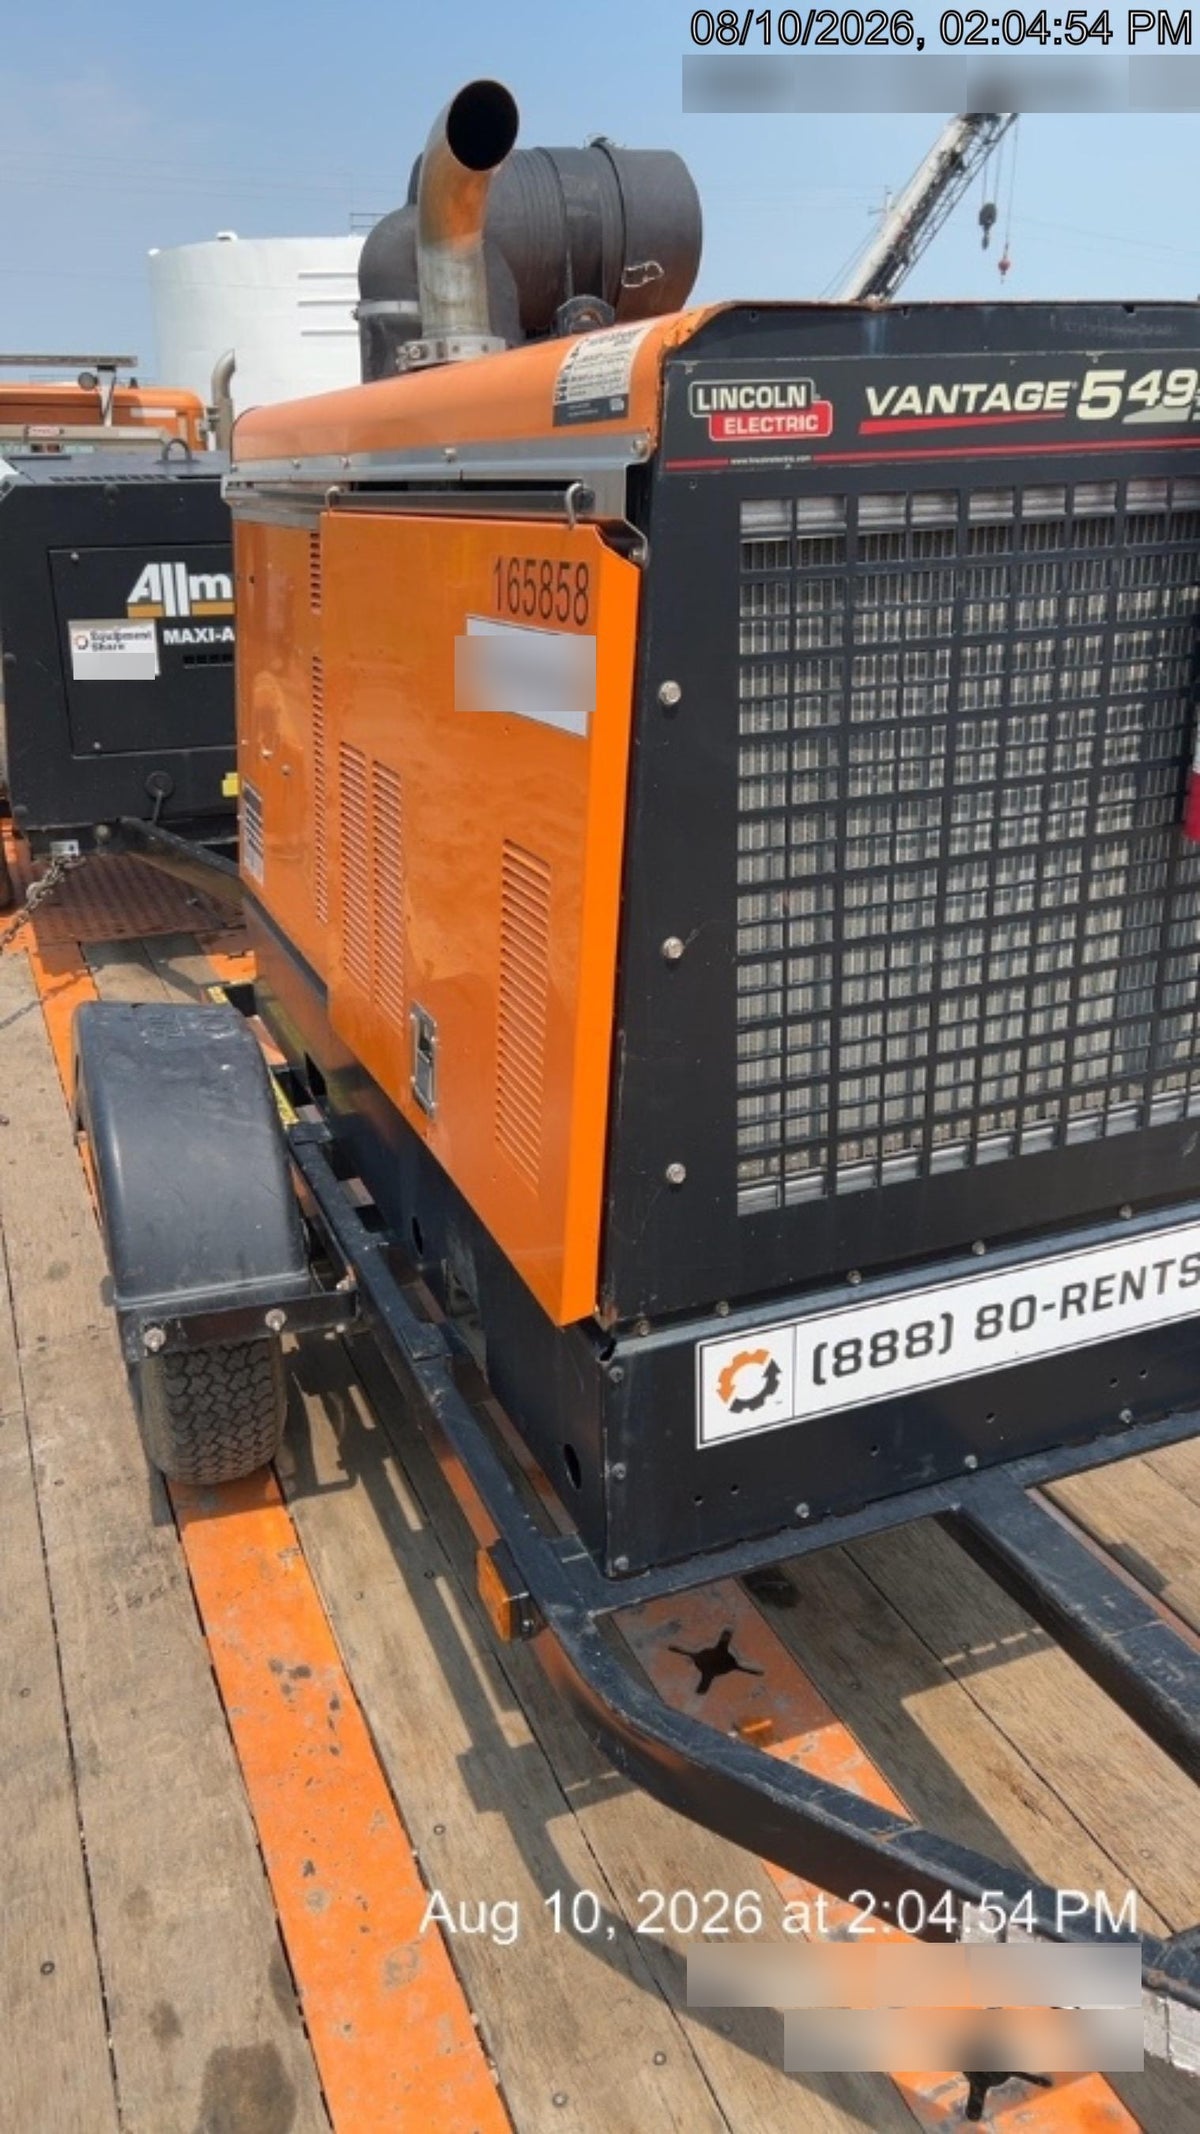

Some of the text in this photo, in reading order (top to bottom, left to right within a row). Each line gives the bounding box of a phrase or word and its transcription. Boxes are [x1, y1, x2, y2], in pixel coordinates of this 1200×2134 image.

[697, 384, 807, 411] LINCOLN
[865, 369, 1200, 421] VANTAGE 549
[723, 414, 819, 435] ELECTRIC
[493, 556, 589, 626] 165858
[812, 1252, 1200, 1386] (888) 80-RENTS
